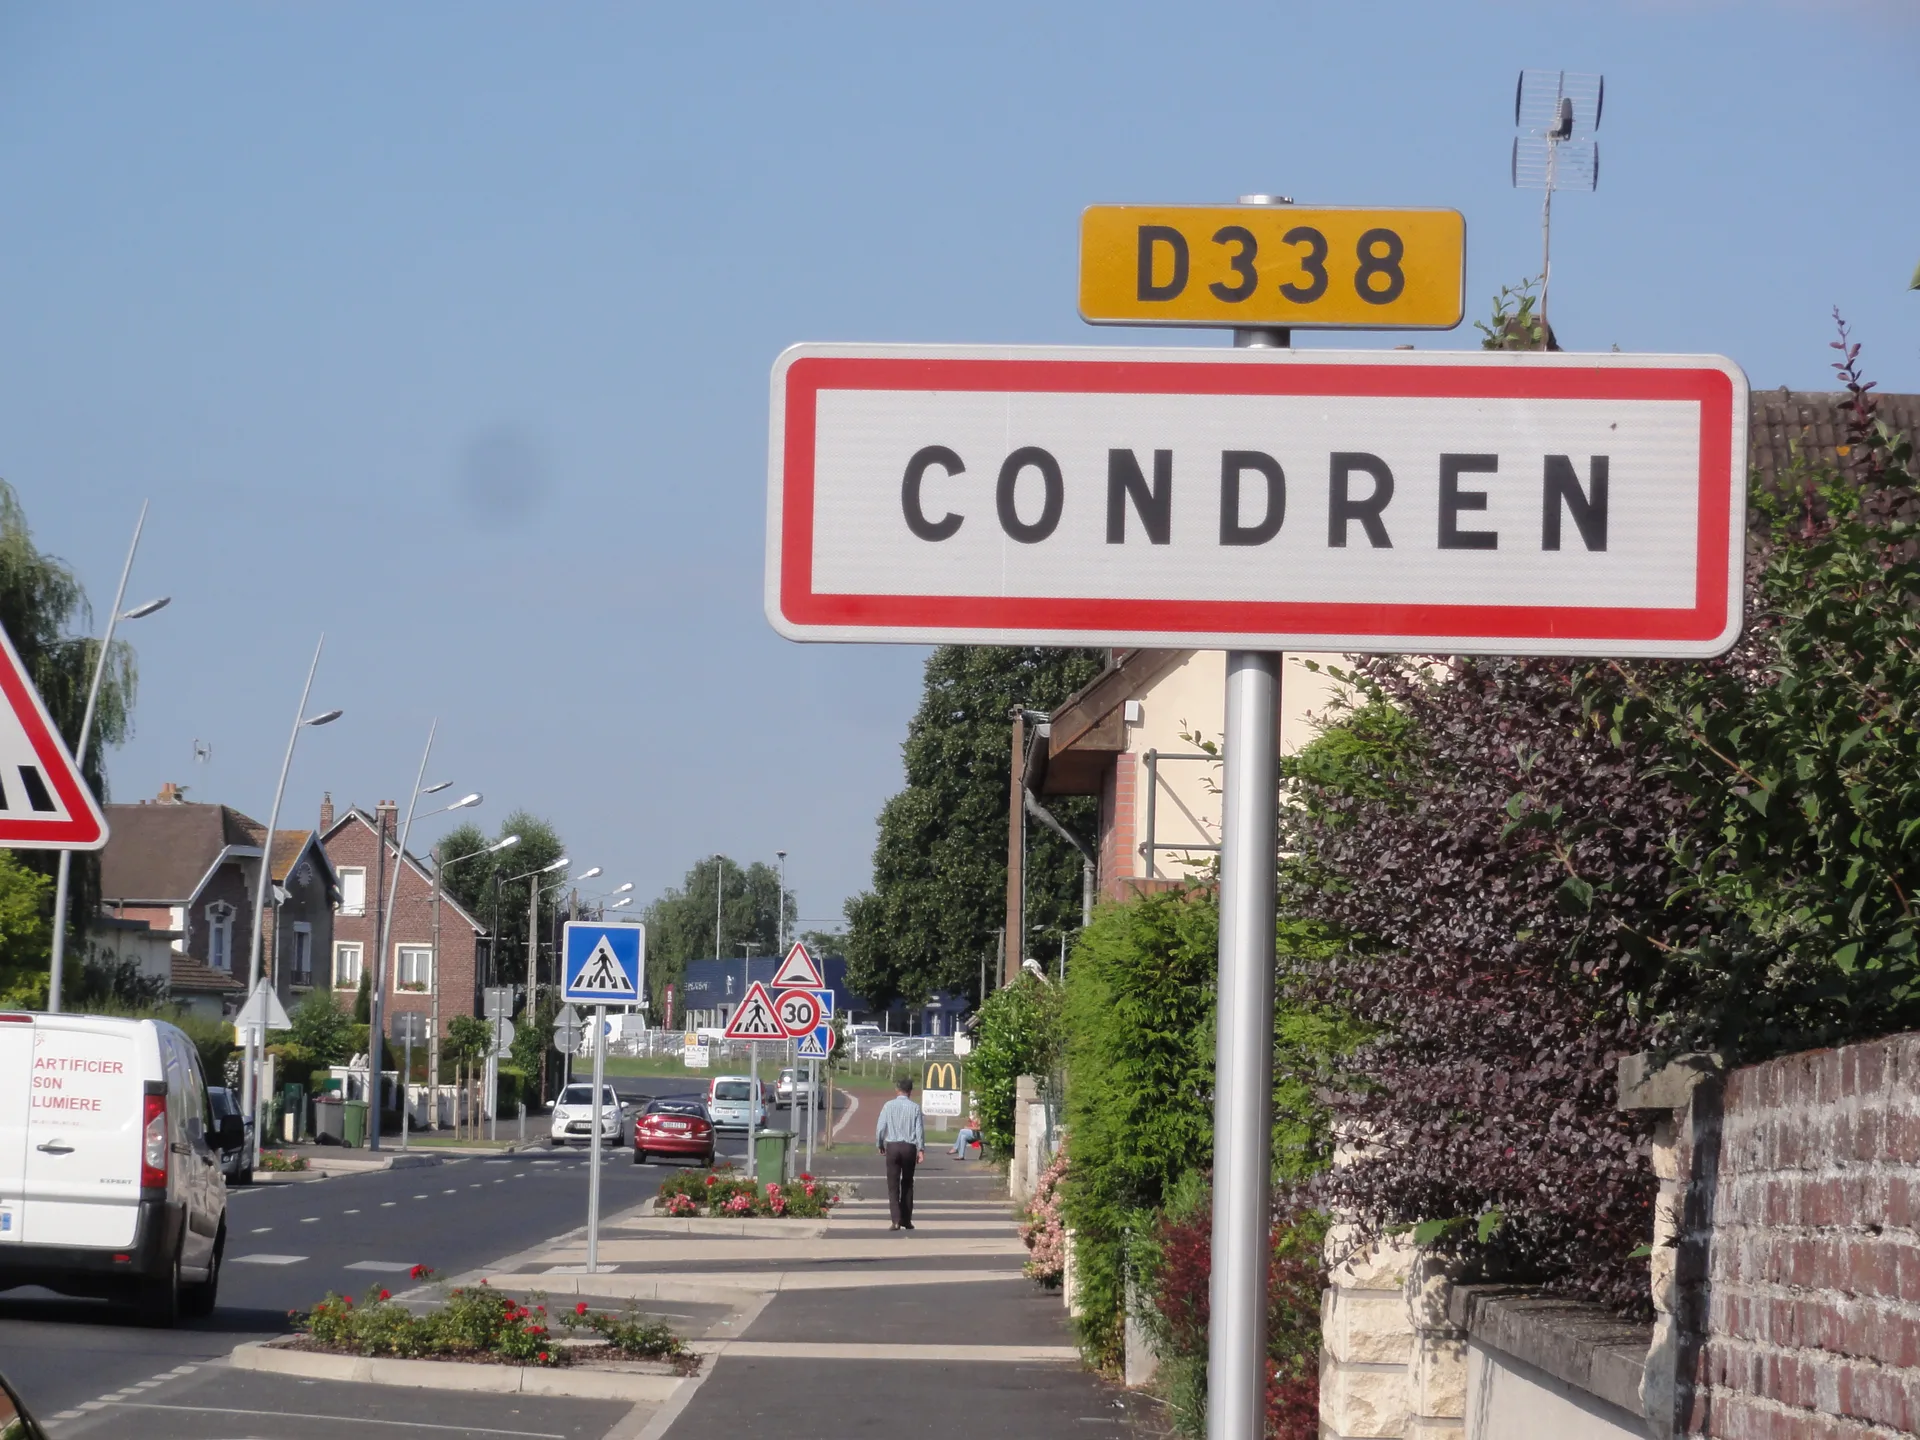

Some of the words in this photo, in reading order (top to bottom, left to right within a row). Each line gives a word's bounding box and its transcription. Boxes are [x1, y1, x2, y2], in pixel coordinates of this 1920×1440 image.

[1137, 225, 1405, 305] D338
[901, 445, 1609, 552] CONDREN
[783, 1003, 812, 1024] 30
[34, 1057, 123, 1074] ARTIFICIER
[32, 1095, 101, 1111] LUMIERE
